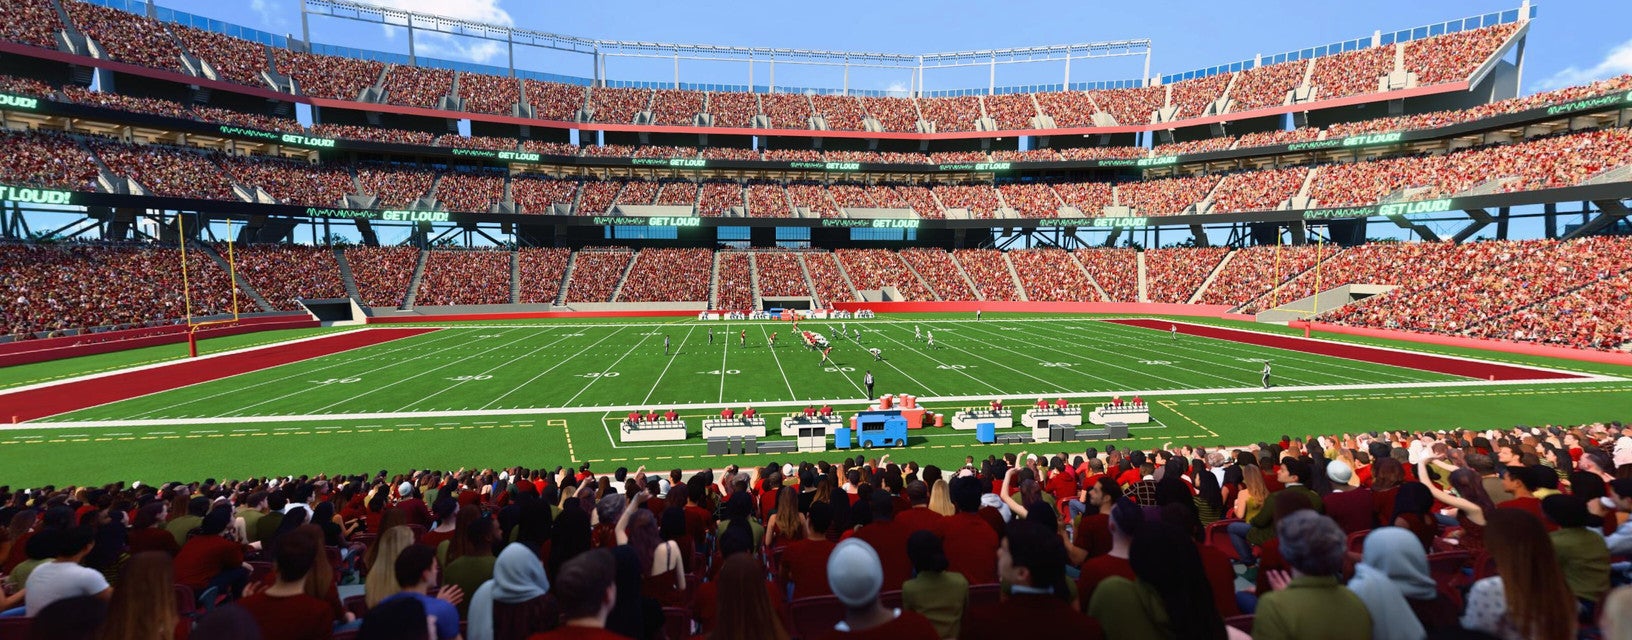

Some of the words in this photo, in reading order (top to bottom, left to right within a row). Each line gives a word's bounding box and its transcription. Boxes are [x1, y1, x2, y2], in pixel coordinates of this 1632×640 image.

[283, 135, 303, 144] GET
[305, 137, 334, 147] LOUD!
[1343, 137, 1366, 146] GET
[1366, 133, 1401, 143] LOUD!
[516, 153, 539, 161] LOUD!
[1153, 156, 1177, 164] LOUD!
[9, 188, 71, 204] LOUD!
[1379, 204, 1407, 215] GET
[1407, 199, 1452, 213] LOUD!
[383, 211, 410, 221] GET
[411, 212, 449, 221] LOUD!
[649, 218, 670, 226] GET
[671, 218, 700, 226] LOUD!
[892, 220, 919, 228] LOUD!
[1094, 218, 1116, 226] GET
[1116, 218, 1146, 226] LOUD!
